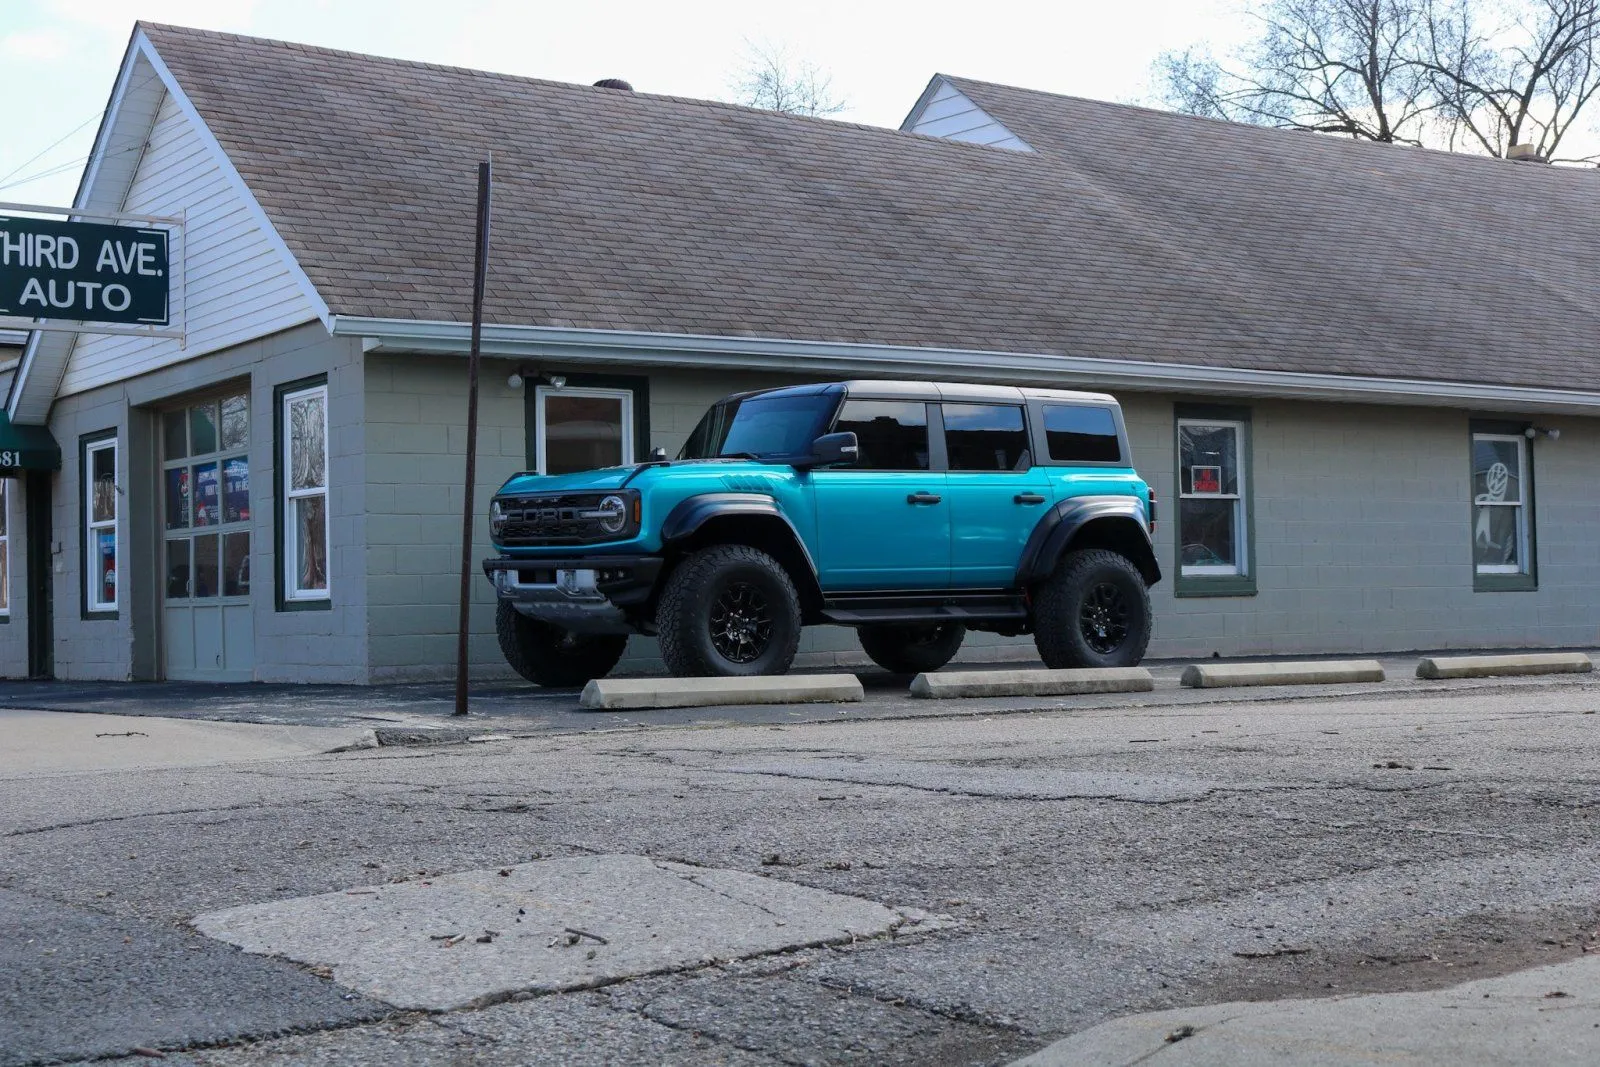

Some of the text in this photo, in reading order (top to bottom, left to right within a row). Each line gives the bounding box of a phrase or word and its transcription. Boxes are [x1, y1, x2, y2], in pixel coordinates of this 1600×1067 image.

[0, 231, 163, 277] HIRD AVE.
[19, 277, 131, 312] AUTO
[0, 451, 21, 467] 81
